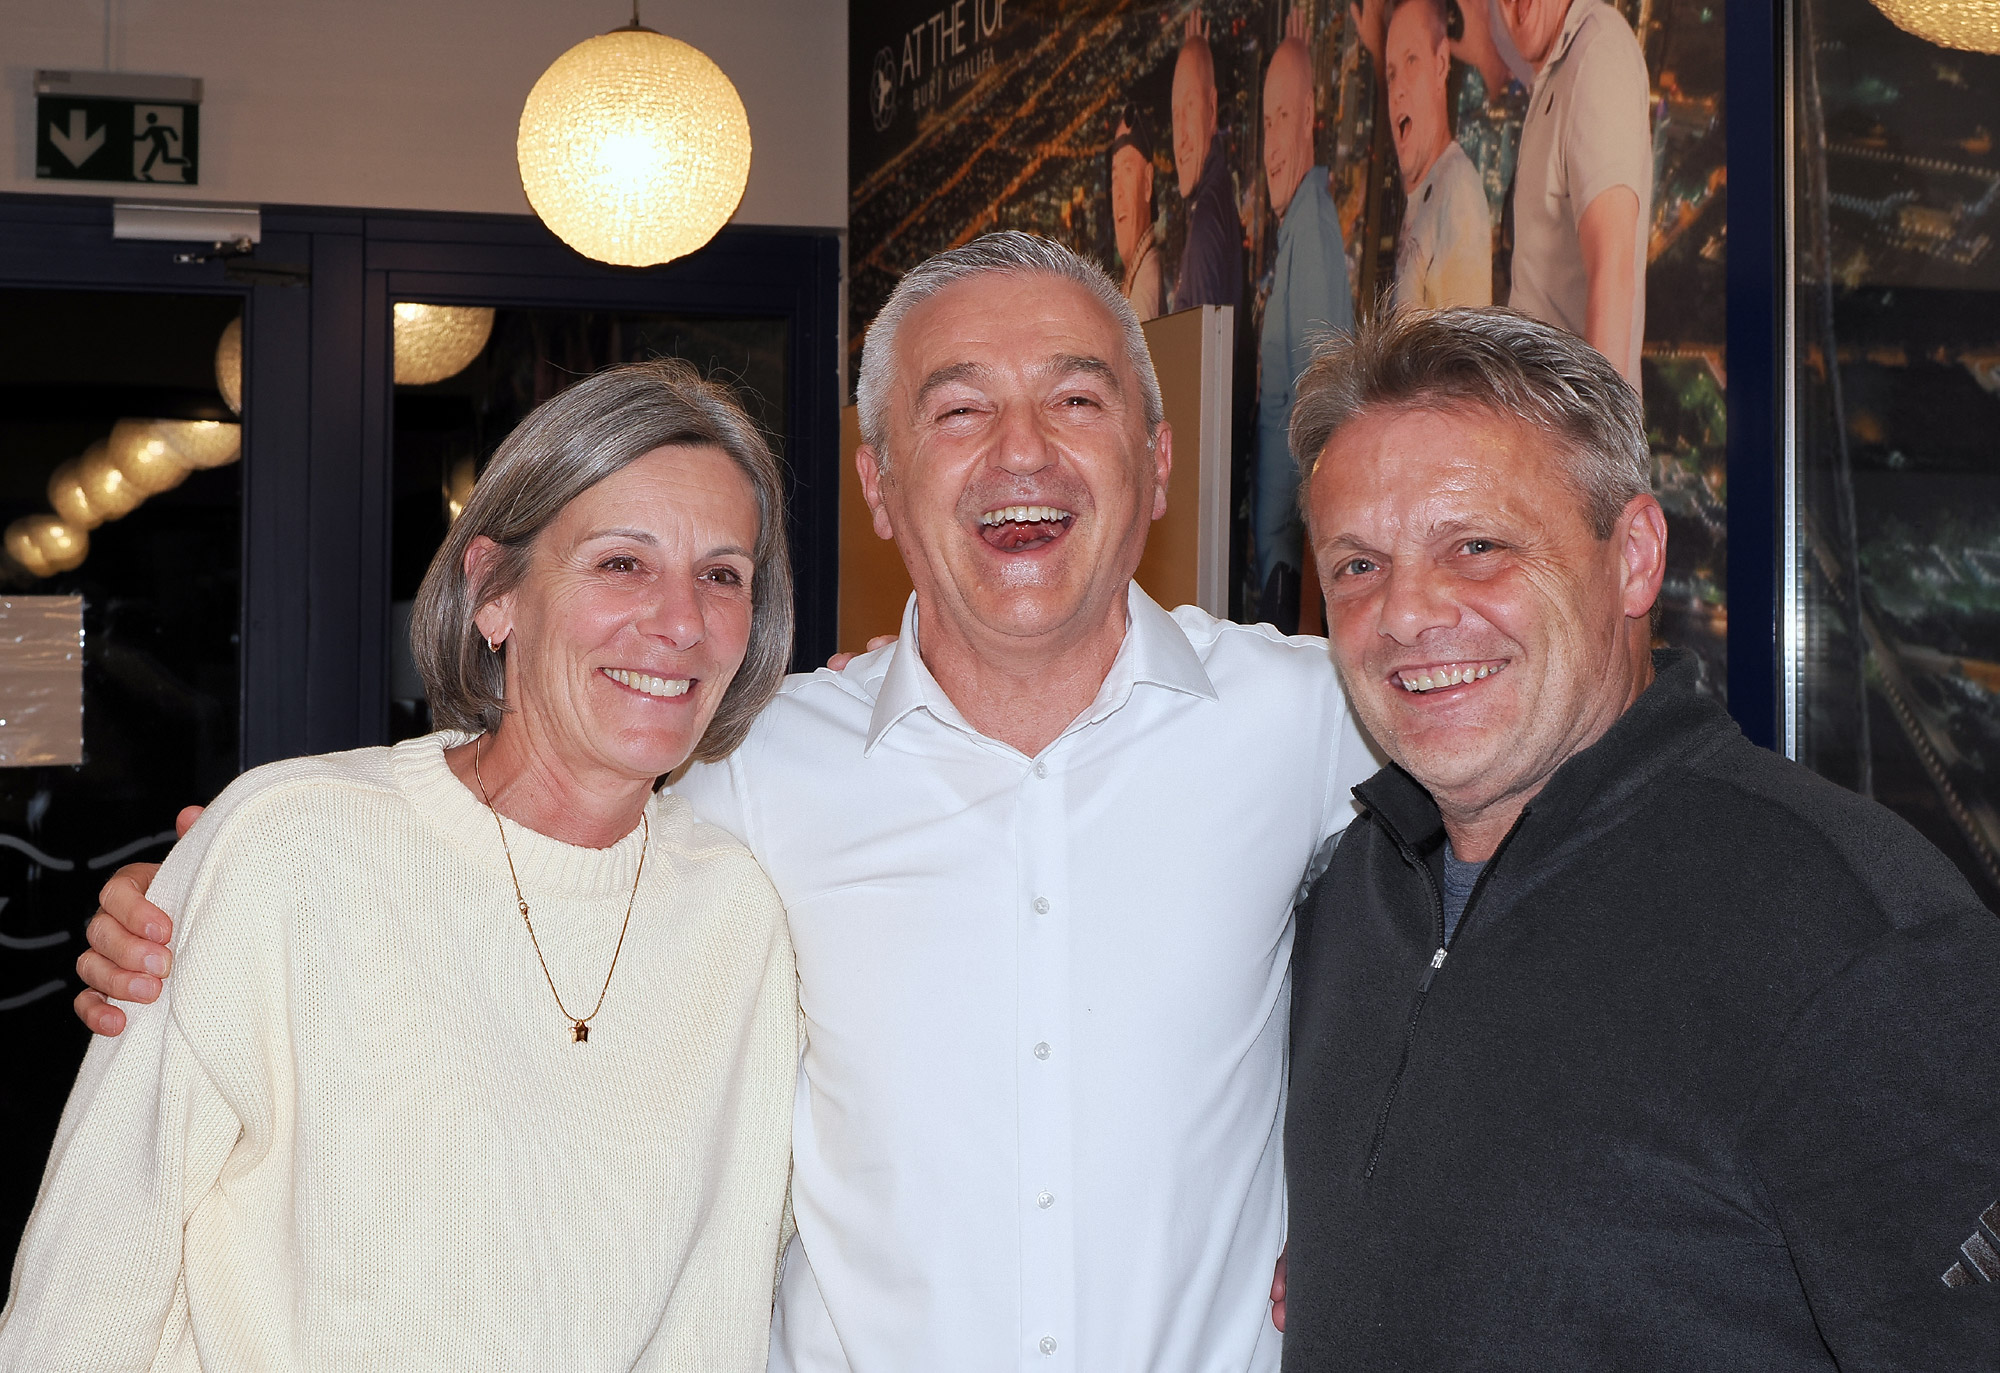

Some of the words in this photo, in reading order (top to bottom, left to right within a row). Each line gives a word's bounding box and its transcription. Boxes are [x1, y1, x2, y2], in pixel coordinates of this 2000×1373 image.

[900, 22, 925, 87] AT
[928, 0, 966, 68] THE
[912, 68, 943, 111] BURJ
[948, 46, 995, 92] KHALIFA
